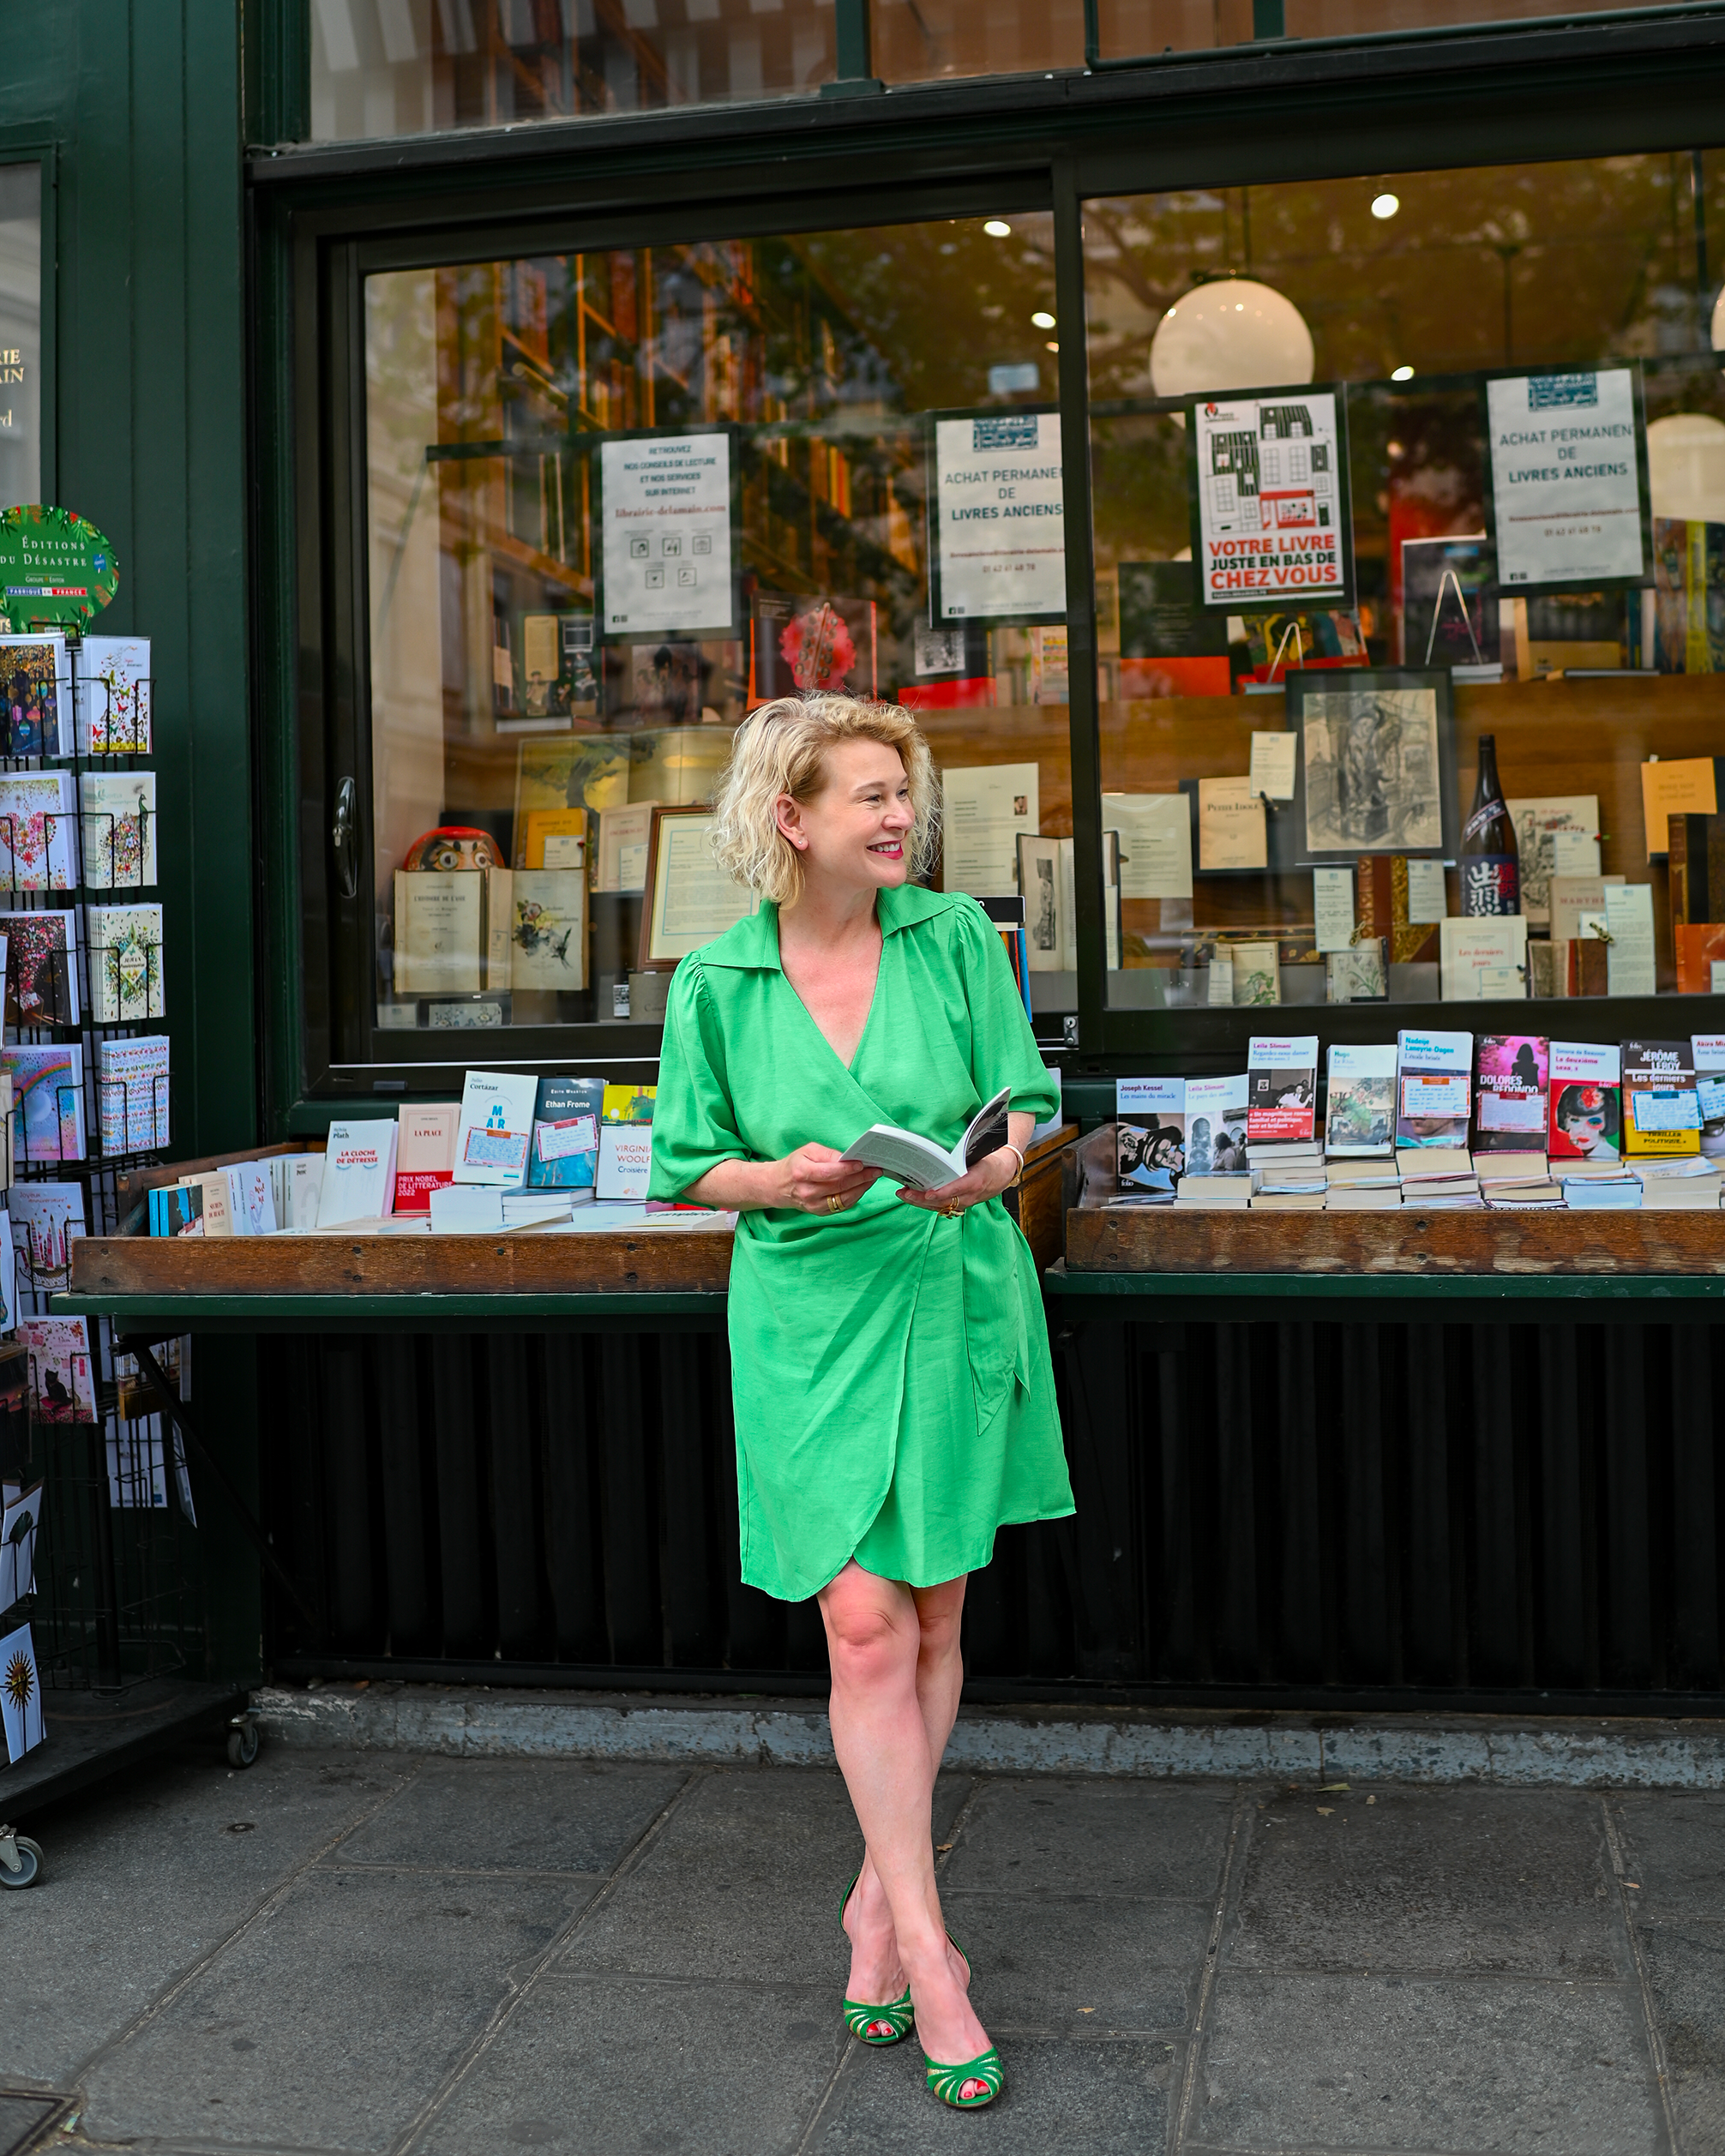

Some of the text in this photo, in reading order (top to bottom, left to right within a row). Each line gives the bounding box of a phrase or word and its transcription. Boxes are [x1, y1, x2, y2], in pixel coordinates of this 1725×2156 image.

[1499, 423, 1633, 447] ACHAT PERMANEN
[648, 445, 692, 454] RETROUVEZ
[1558, 446, 1578, 460] DE
[674, 459, 684, 469] DE
[685, 457, 717, 468] LECTURE
[640, 471, 701, 483] ET NOS SERVICES
[945, 471, 989, 484] ACHAT
[1509, 462, 1629, 484] LIVRES ANCIENS
[645, 486, 696, 497] SUR INTERNET
[998, 487, 1016, 499] DE
[952, 504, 1063, 520] LIVRES ANCIENS
[22, 535, 85, 550] ÉDITIONS
[1209, 534, 1335, 556] VOTRE LIVRE
[0, 556, 15, 564] DU
[23, 554, 87, 567] DÉSASTRE
[1211, 551, 1337, 571] JUSTE EN BAS DE
[1211, 565, 1337, 590] CHEZ VOUS
[1640, 1048, 1679, 1062] JÉRÔME
[1651, 1060, 1680, 1070] LEROY
[1480, 1074, 1523, 1085] DOLORES
[1632, 1073, 1686, 1083] Les derniers
[470, 1083, 498, 1091] Cortázar
[1652, 1083, 1675, 1091] jours
[545, 1100, 591, 1108] Ethan Frome
[491, 1105, 503, 1116] M
[615, 1144, 652, 1153] VIRGINIA
[617, 1155, 651, 1163] WOOLF
